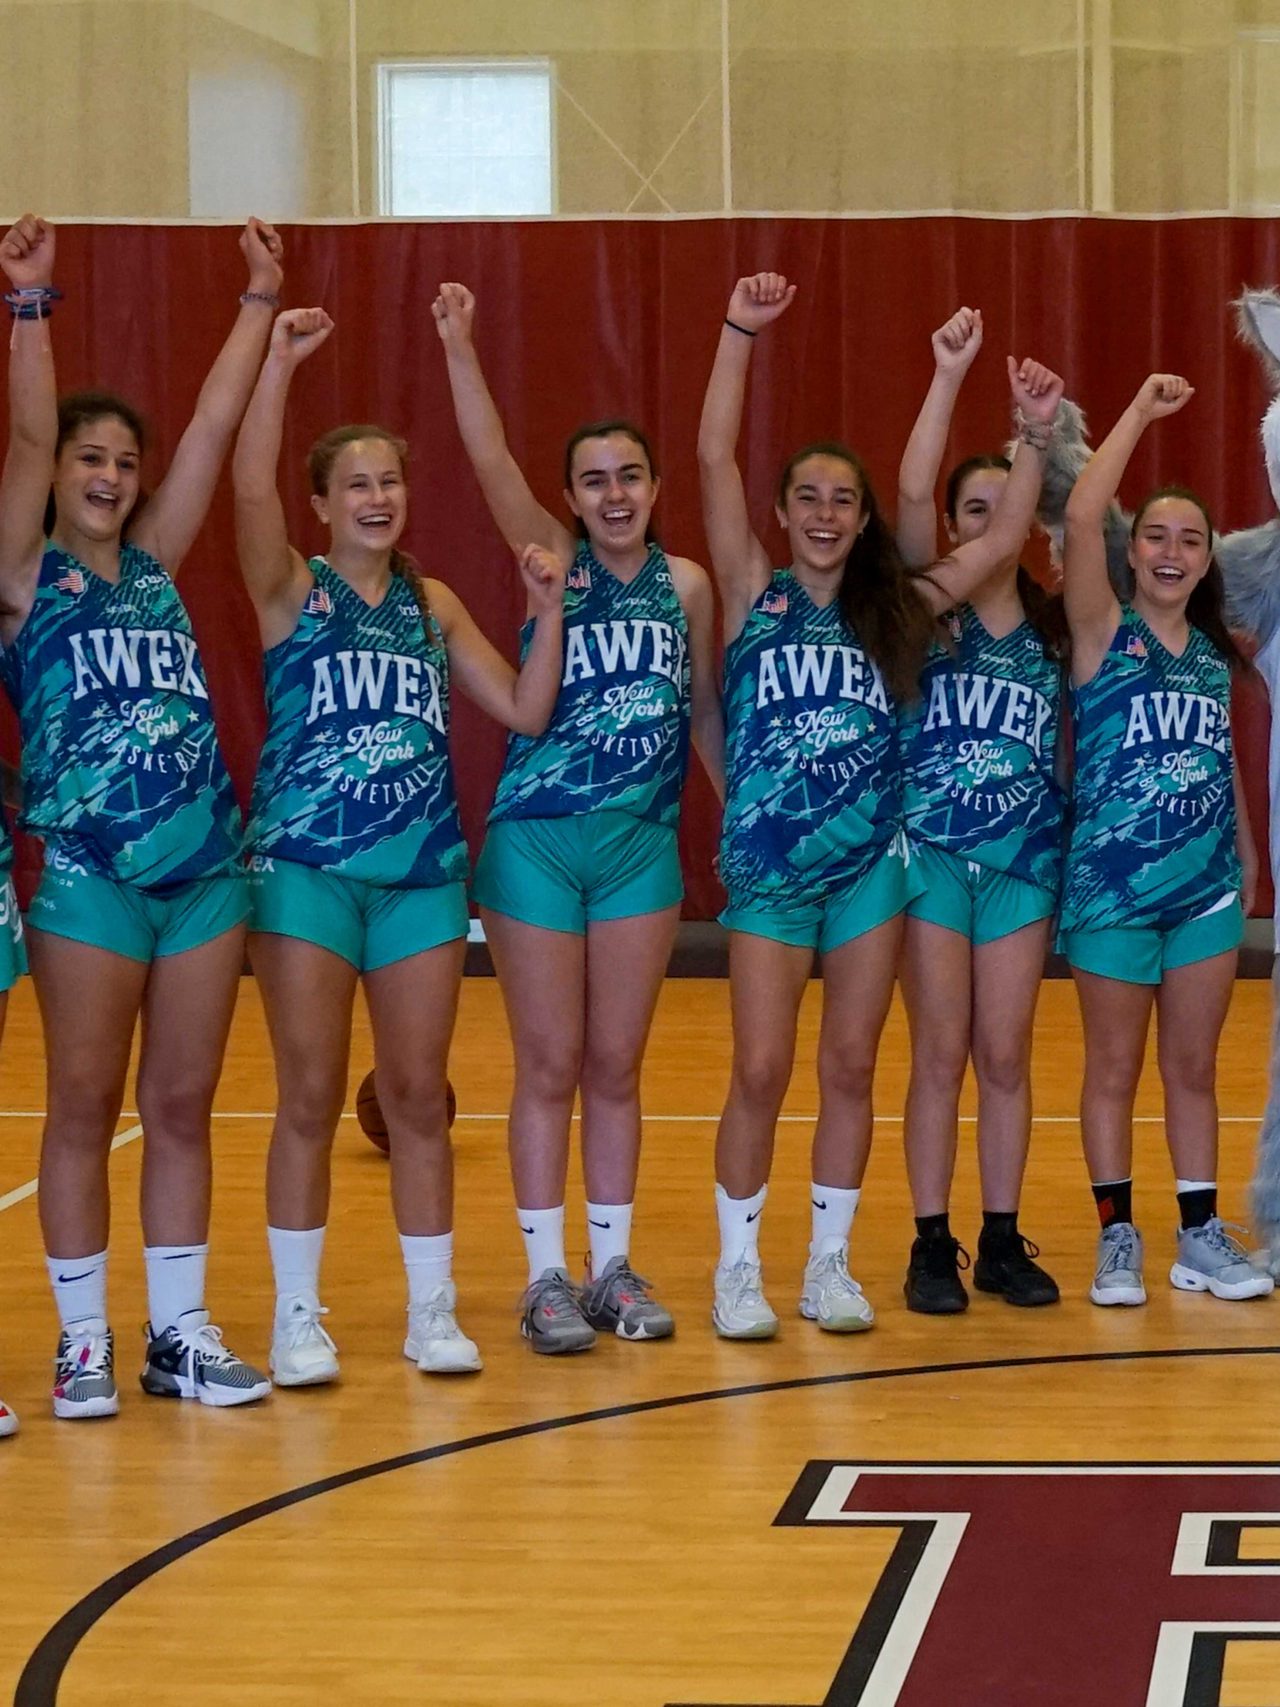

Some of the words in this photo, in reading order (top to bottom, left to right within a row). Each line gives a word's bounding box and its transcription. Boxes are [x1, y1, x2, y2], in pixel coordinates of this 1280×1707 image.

[69, 627, 210, 700] AWEX
[306, 650, 446, 736] AWEX
[603, 680, 655, 711] New
[612, 701, 665, 731] York
[794, 705, 847, 737] New
[923, 673, 1052, 759] AWEX
[346, 721, 403, 754] New
[805, 727, 860, 756] York
[958, 740, 1004, 764] New
[357, 745, 414, 774] York
[967, 759, 1013, 785] York
[1161, 750, 1199, 774] New
[317, 753, 436, 804] BASKETBALL
[935, 764, 1031, 812] BASKETBALL
[1171, 766, 1208, 792] York
